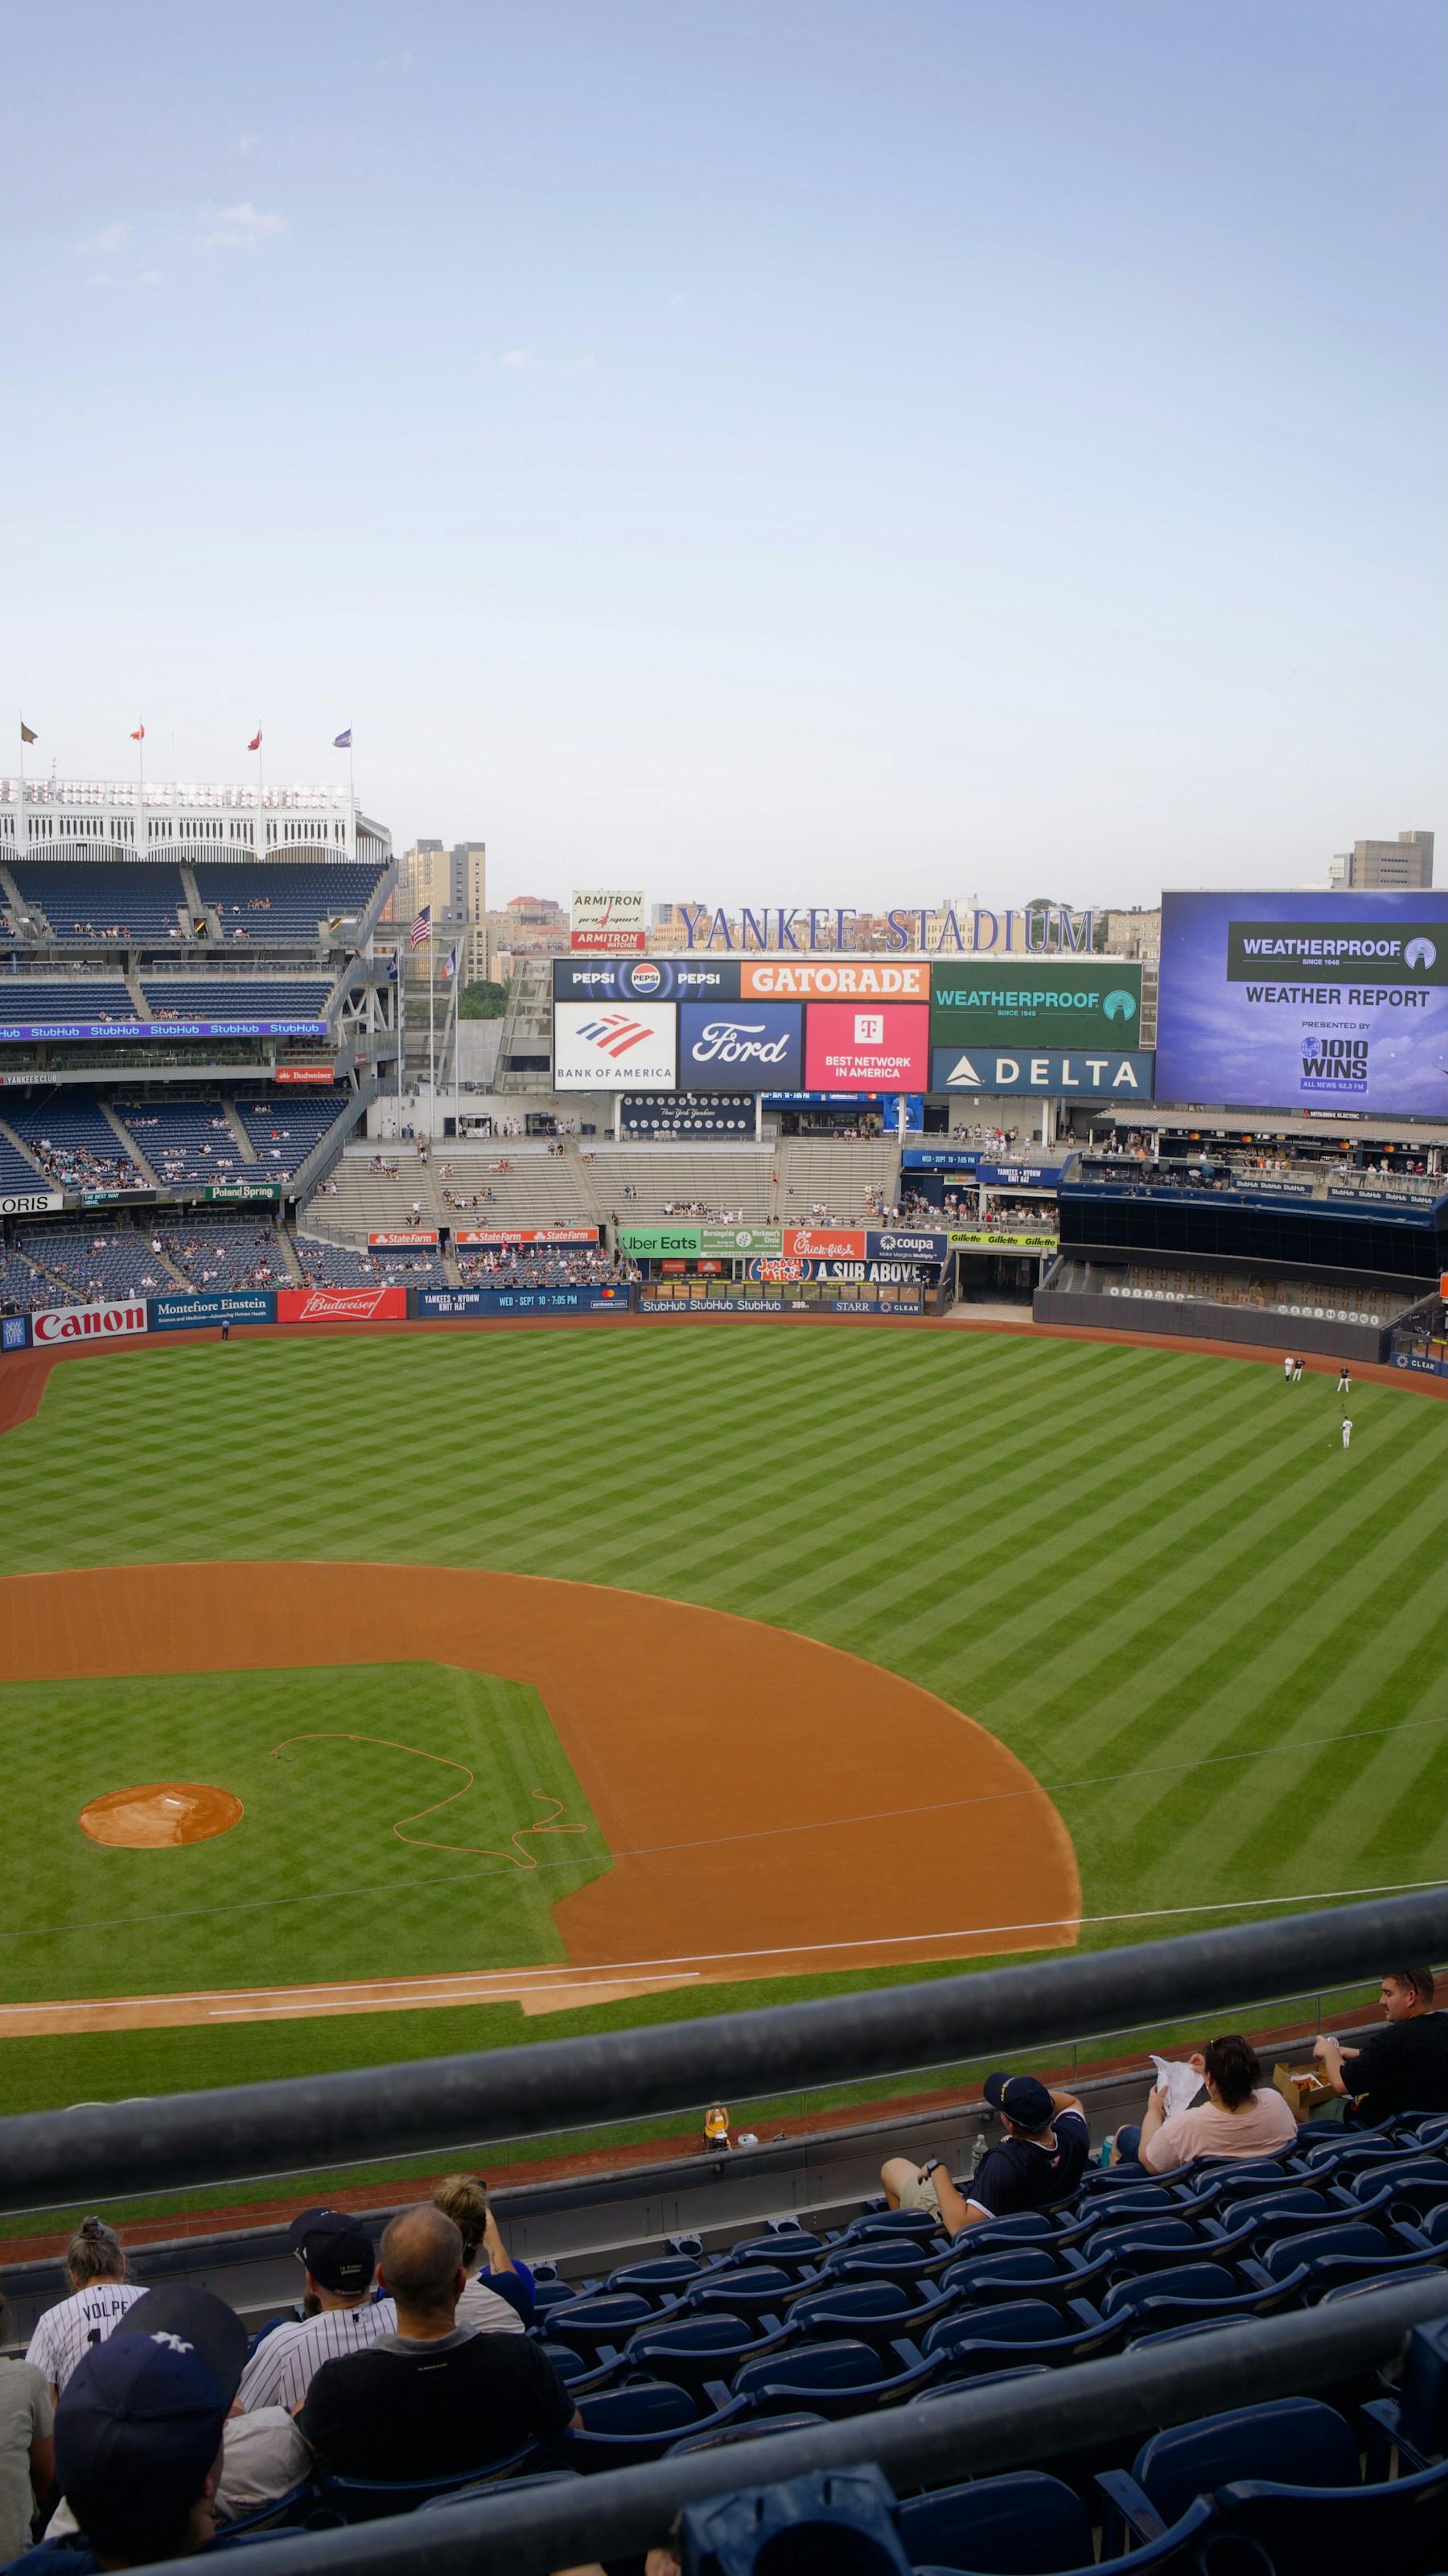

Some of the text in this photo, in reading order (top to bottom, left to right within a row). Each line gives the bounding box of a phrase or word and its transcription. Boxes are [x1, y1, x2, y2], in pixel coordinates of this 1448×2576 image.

[574, 896, 642, 906] ARMITRON
[676, 907, 1096, 953] YANKEE STADIUM
[577, 934, 638, 943] ARMITRON
[1243, 939, 1401, 957] WEATHERPROOF
[572, 973, 615, 984] PEPSI
[678, 973, 720, 984] PEPSI
[752, 967, 919, 993] GATORADE
[936, 991, 1099, 1008] WEATHERPROOF
[1246, 986, 1430, 1007] WEATHER REPORT
[150, 1026, 199, 1034] StubHub
[210, 1025, 259, 1033] StubHub
[270, 1024, 319, 1033] StubHub
[1302, 1021, 1355, 1029] PRESENTED
[31, 1028, 79, 1037] StubHub
[90, 1027, 140, 1035] StubHub
[692, 1023, 790, 1063] Ford
[1321, 1039, 1368, 1059] 1010
[826, 1056, 911, 1068] BEST NETWORK
[557, 1069, 672, 1078] BANK OF AMERICA
[836, 1068, 900, 1078] IN AMERICA
[996, 1058, 1138, 1088] DELTA
[1302, 1058, 1367, 1079] WINS
[6, 1076, 38, 1084] YANKEES
[660, 1108, 716, 1119] New York Yankees
[997, 1168, 1018, 1176] YANKEES
[212, 1186, 273, 1198] Poland Spring
[1332, 1188, 1354, 1197] StubHub
[1386, 1193, 1407, 1201] StubHub
[2, 1196, 48, 1212] ORIS
[703, 1230, 734, 1238] Morningside
[952, 1234, 981, 1243] Gillette
[622, 1237, 697, 1249] Uber Eats
[793, 1232, 854, 1255] Chick-fil-A
[897, 1238, 934, 1251] coupa
[989, 1236, 1018, 1245] Gillette
[1025, 1237, 1055, 1246] Gillette
[757, 1258, 803, 1272] Jersey
[818, 1262, 921, 1282] A SUB ABOVE
[424, 1295, 451, 1304] YANKEES
[499, 1295, 577, 1307] WED SEPT 10 7:05 PM
[158, 1298, 266, 1315] Montefiore Einstein
[307, 1298, 378, 1312] Budweiser
[439, 1303, 466, 1312] KNIT HAT
[643, 1301, 686, 1311] StubHub
[690, 1301, 733, 1311] StubHub
[737, 1300, 781, 1311] StubHub
[836, 1302, 869, 1311] STARR
[6, 1322, 21, 1330] NEW
[34, 1307, 144, 1340] Canon
[5, 1328, 23, 1337] YORK
[7, 1335, 22, 1344] LIFE
[1411, 1360, 1434, 1370] CLEAR
[82, 2300, 128, 2321] VOLPE
